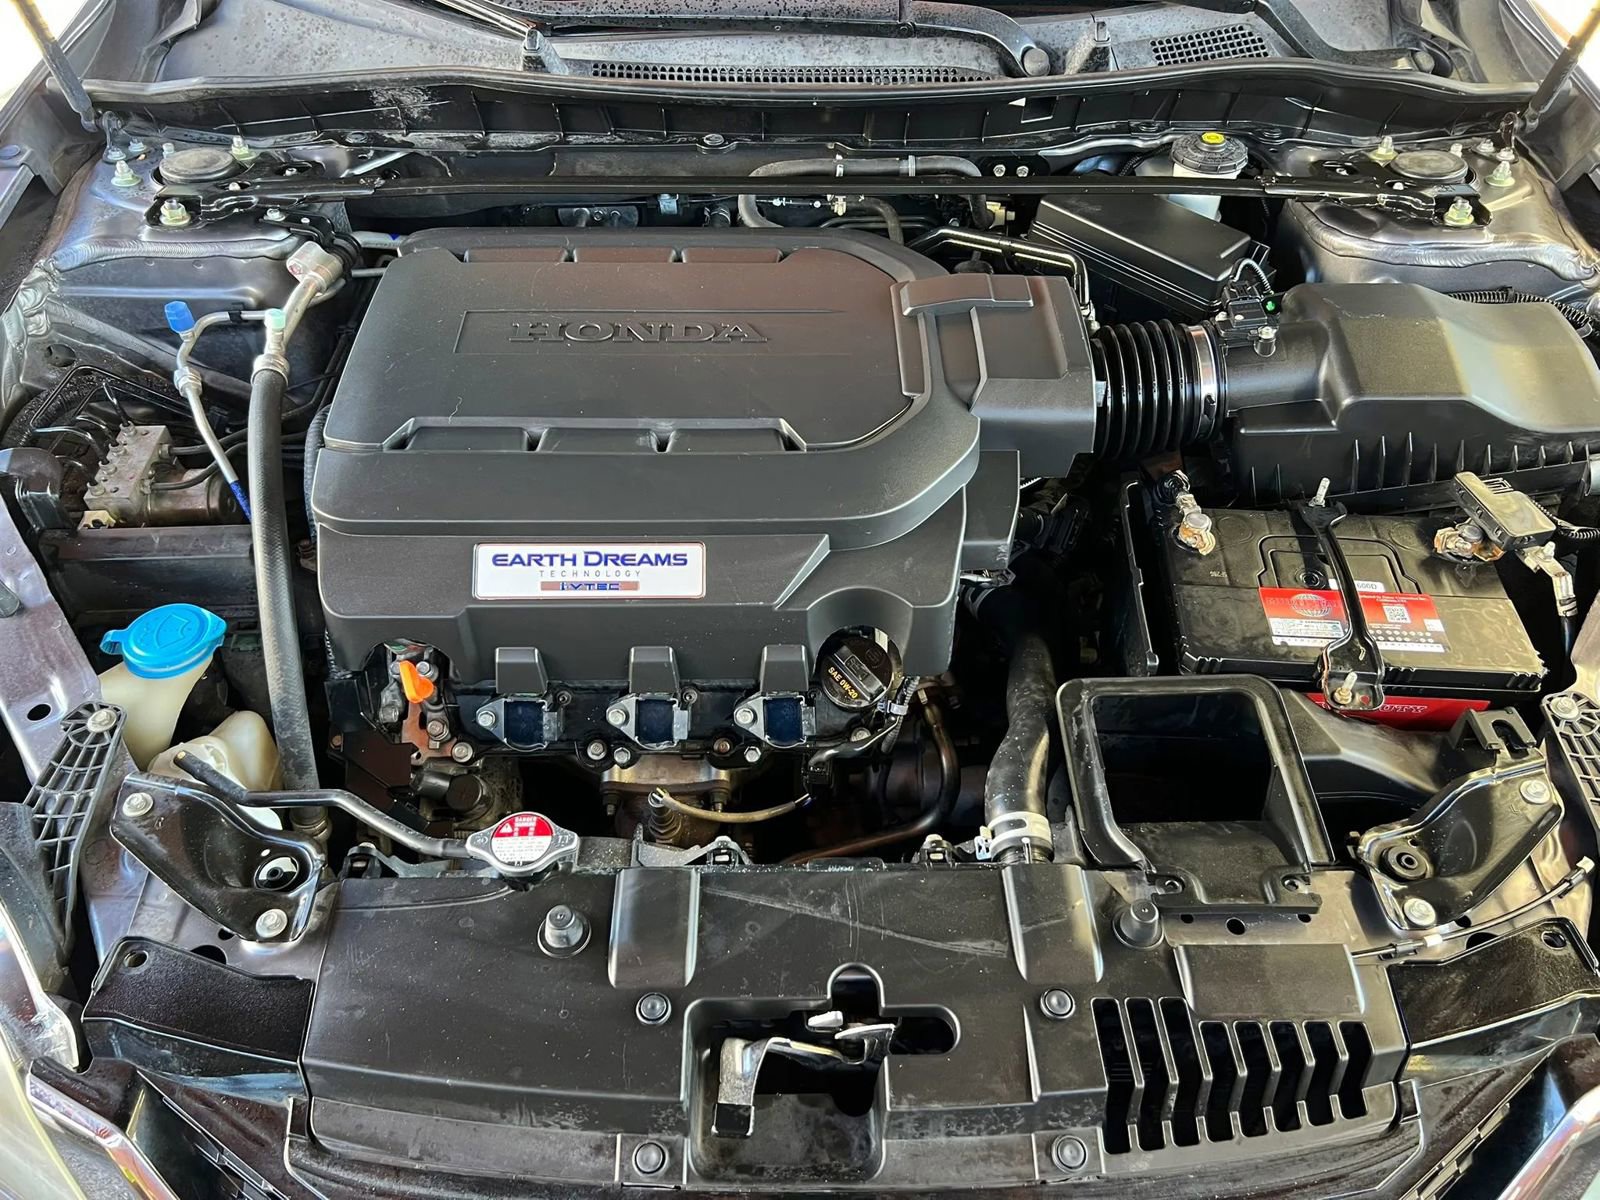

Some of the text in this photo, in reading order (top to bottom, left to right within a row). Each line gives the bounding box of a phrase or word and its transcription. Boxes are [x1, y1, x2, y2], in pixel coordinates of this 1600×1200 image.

[508, 321, 768, 342] HONDA
[491, 551, 688, 567] EARTH DREAMS
[539, 569, 641, 578] TECHNOLOGY
[827, 666, 843, 682] SAE
[839, 679, 859, 699] 0W-20
